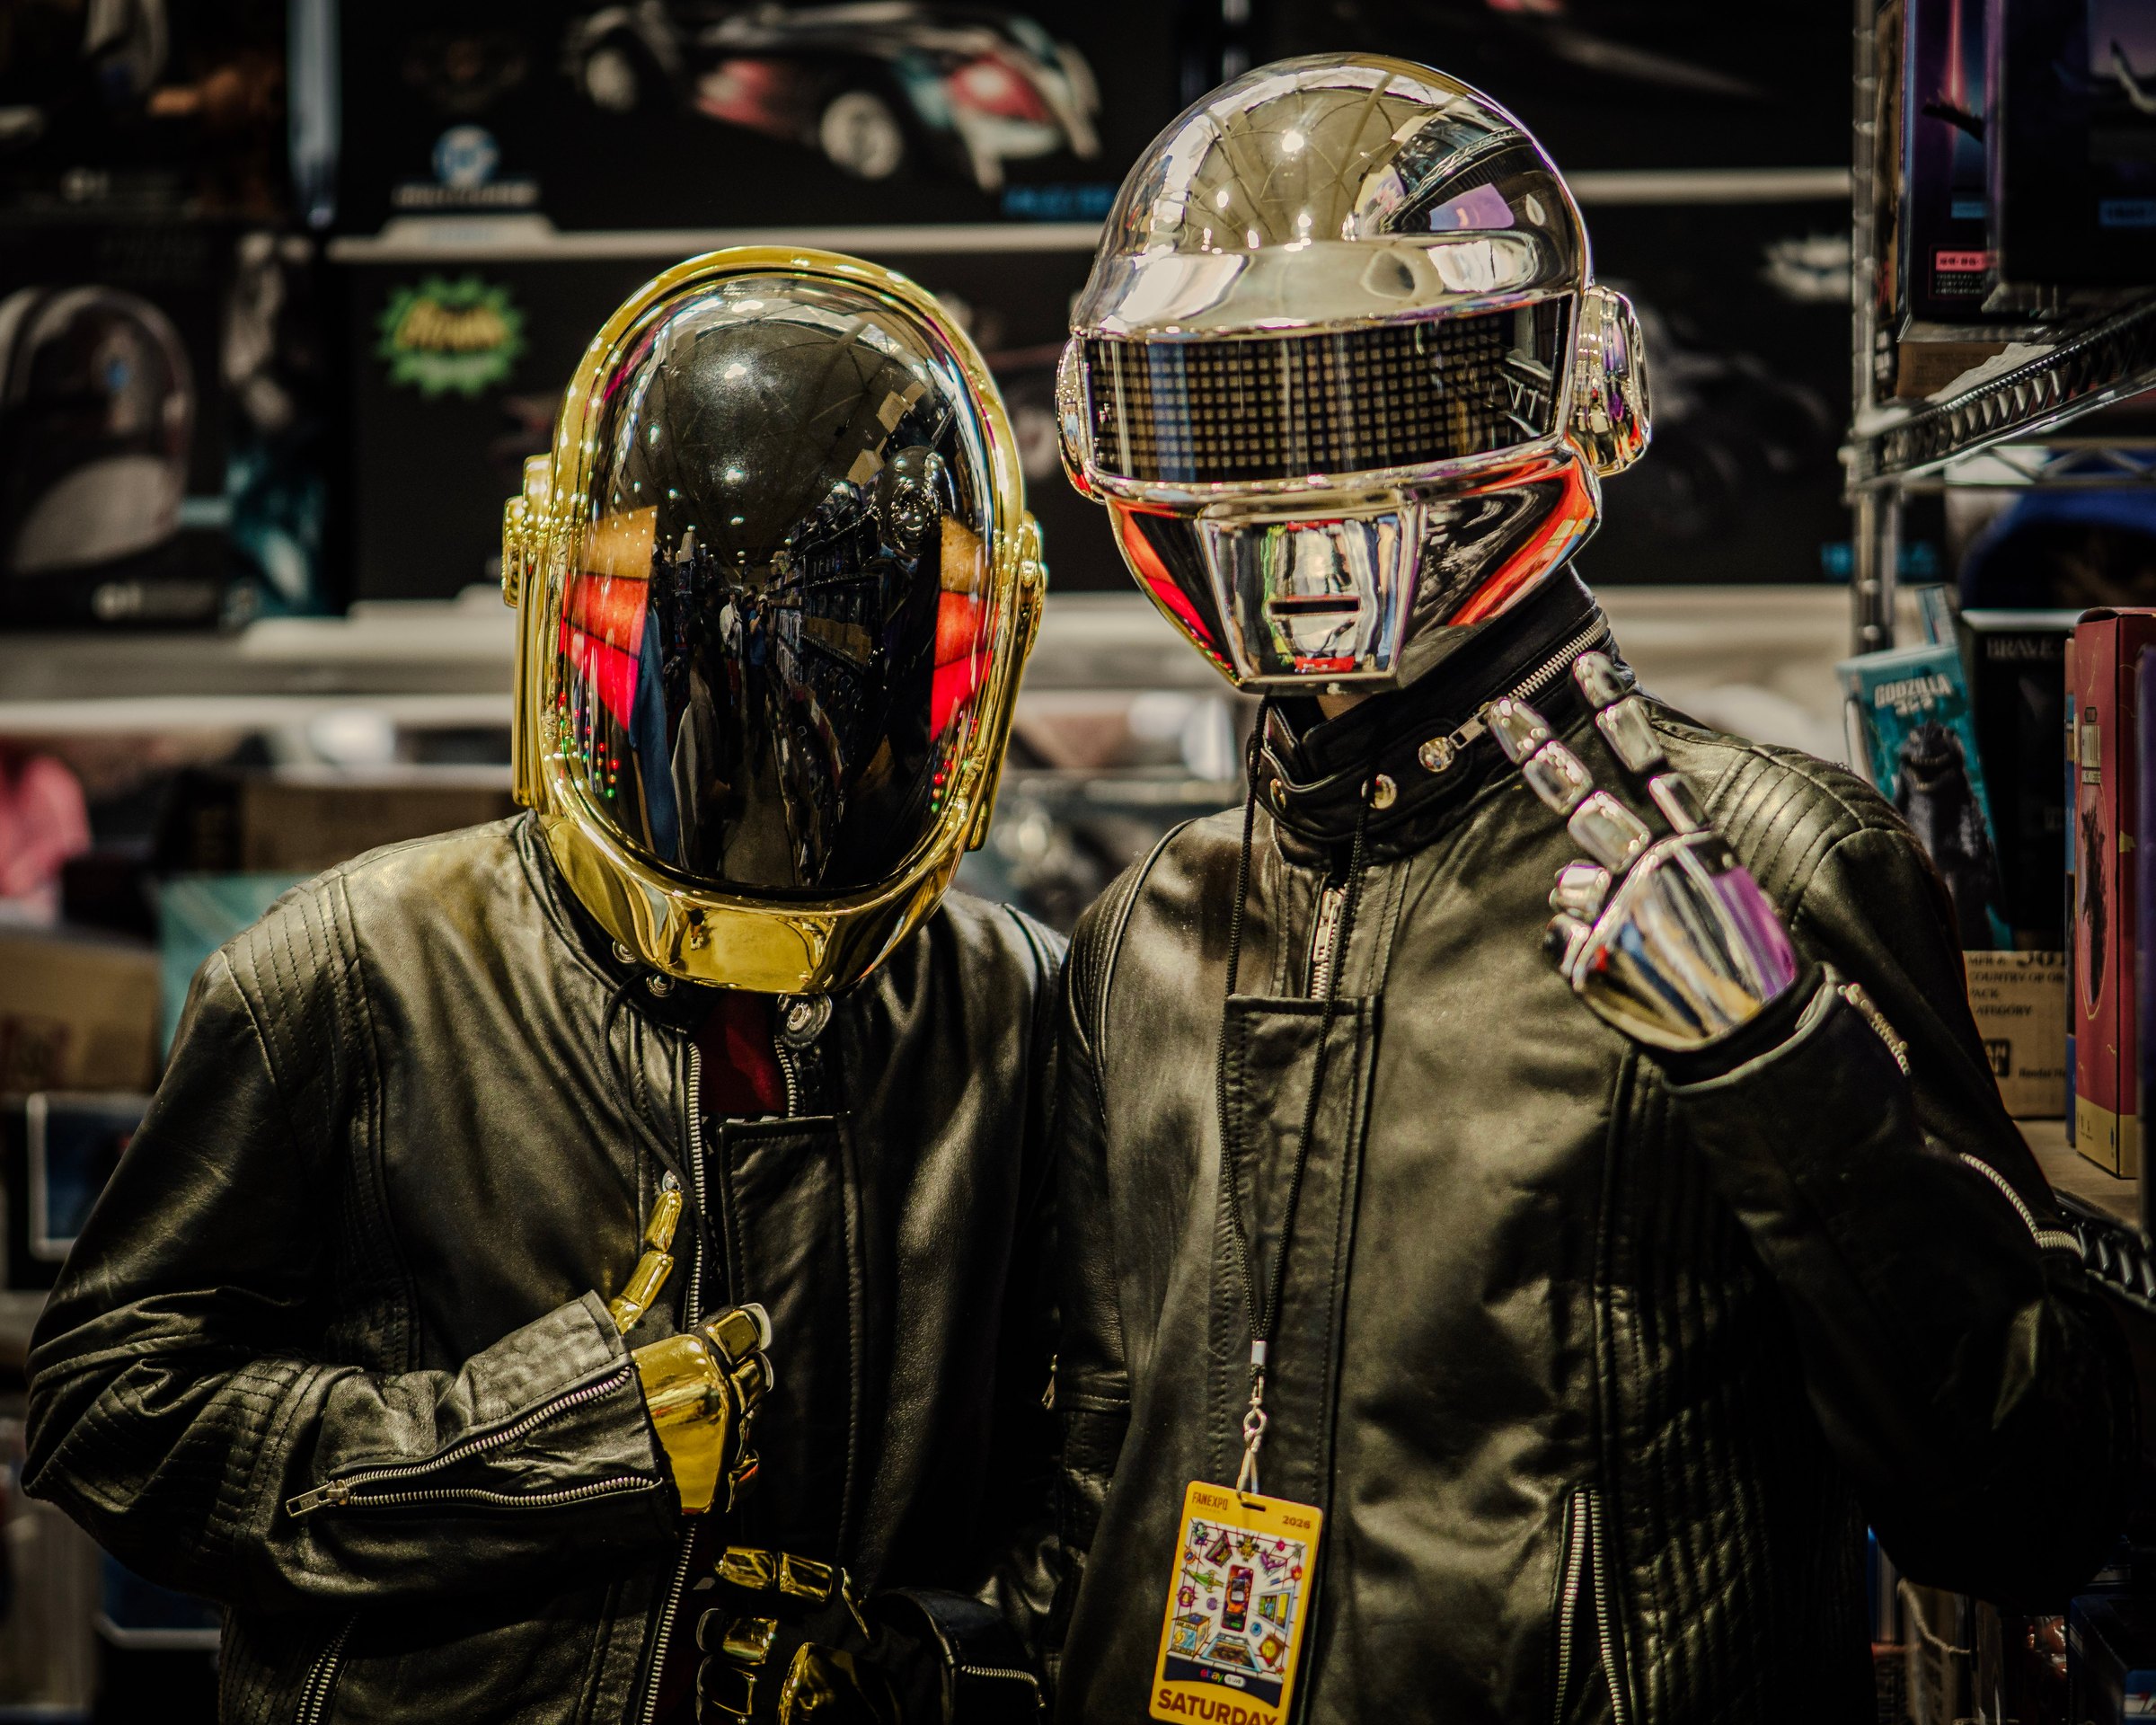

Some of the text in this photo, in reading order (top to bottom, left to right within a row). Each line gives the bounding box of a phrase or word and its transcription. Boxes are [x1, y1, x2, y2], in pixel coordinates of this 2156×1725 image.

[1874, 673, 1951, 710] GODZILLA
[1968, 972, 2025, 983] COUNTRY
[2028, 972, 2045, 984] OF
[1282, 1515, 1311, 1529] 2026
[1200, 1668, 1224, 1684] ebay
[1157, 1687, 1278, 1725] SATURDAY
